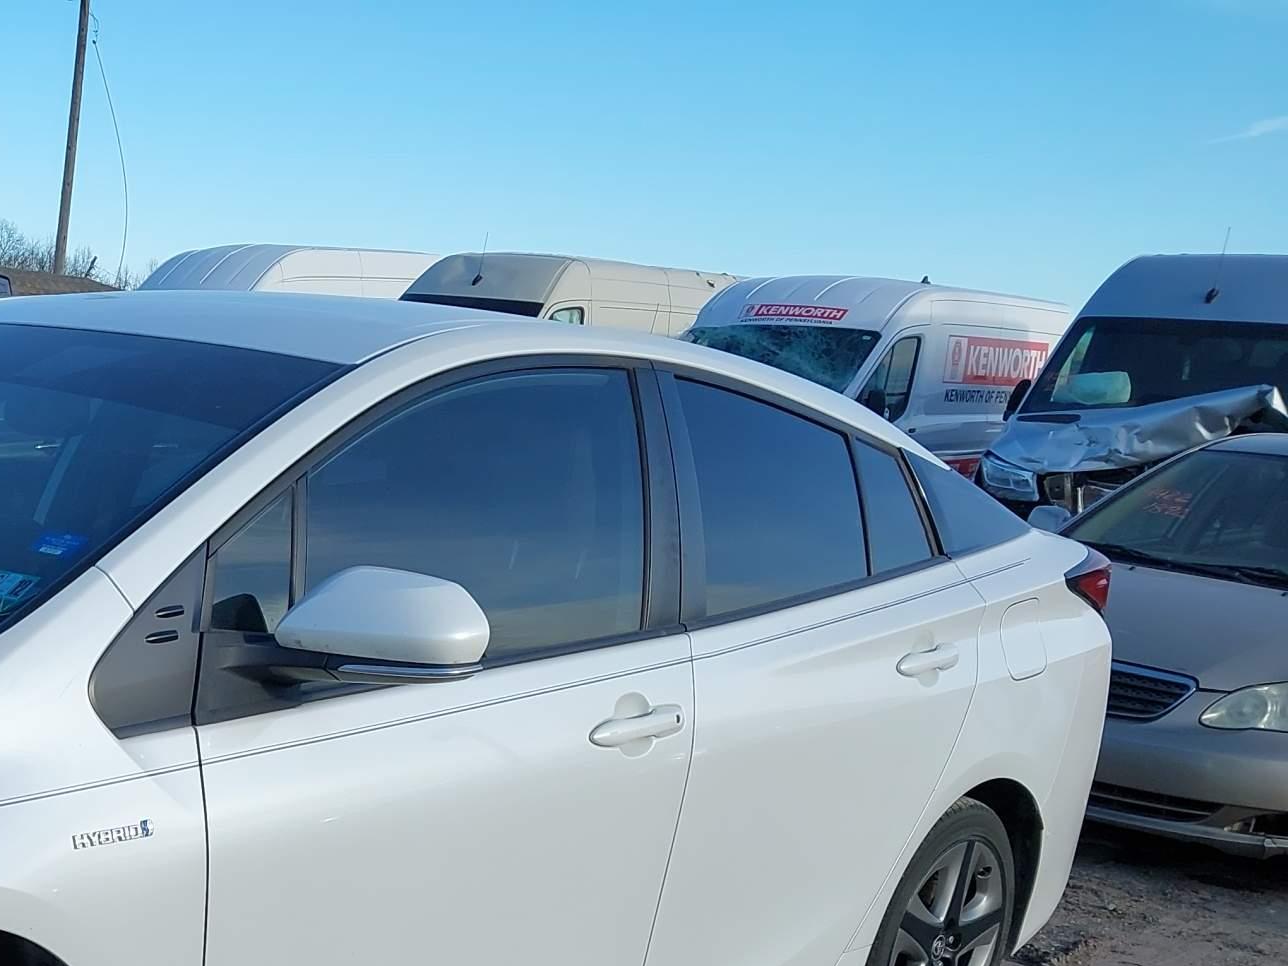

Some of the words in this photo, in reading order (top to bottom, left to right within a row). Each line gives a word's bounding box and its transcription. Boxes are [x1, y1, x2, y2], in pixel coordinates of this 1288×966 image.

[758, 305, 845, 319] KENWORTH
[967, 344, 1046, 380] KENWORTH
[943, 388, 985, 403] KENWORTH
[985, 390, 995, 404] OF
[72, 823, 140, 850] HYBRID
